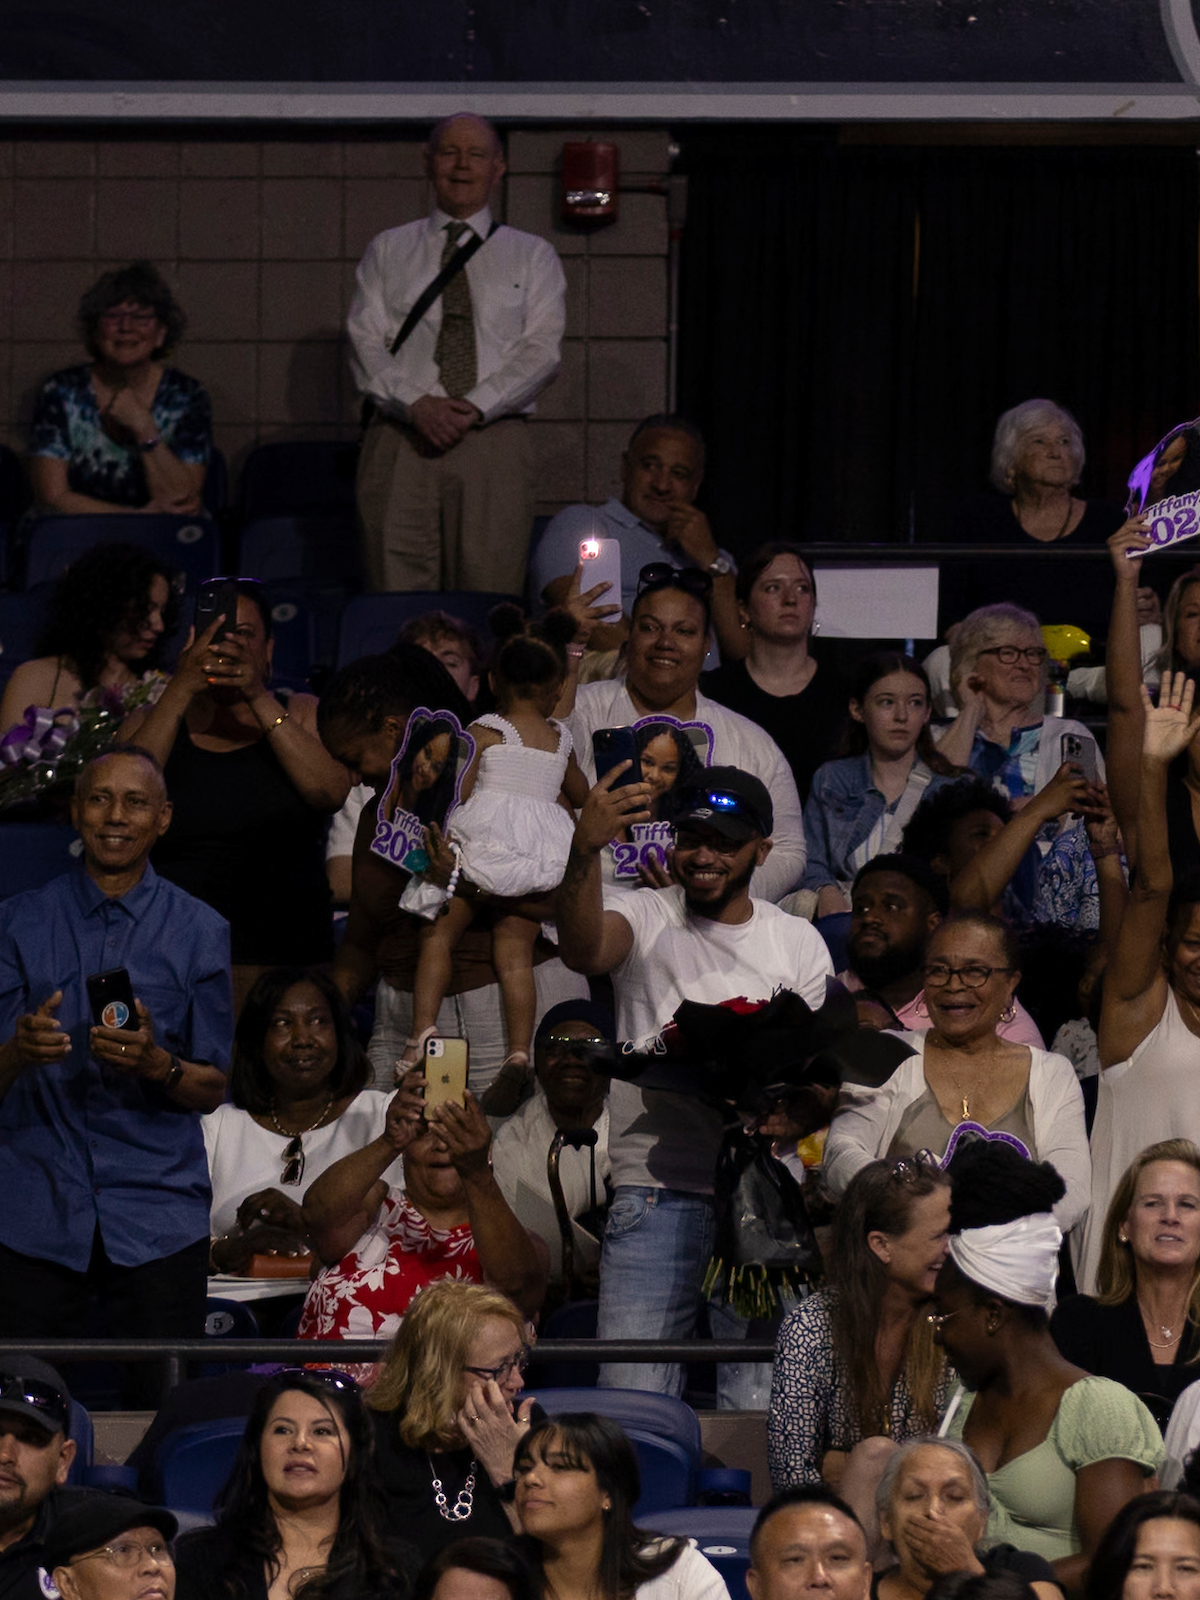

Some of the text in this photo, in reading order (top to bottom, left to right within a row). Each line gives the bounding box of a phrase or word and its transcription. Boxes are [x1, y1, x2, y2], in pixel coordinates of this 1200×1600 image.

[372, 821, 421, 861] 20
[633, 822, 674, 841] Tiff
[616, 842, 674, 875] 20
[213, 1316, 223, 1330] 5
